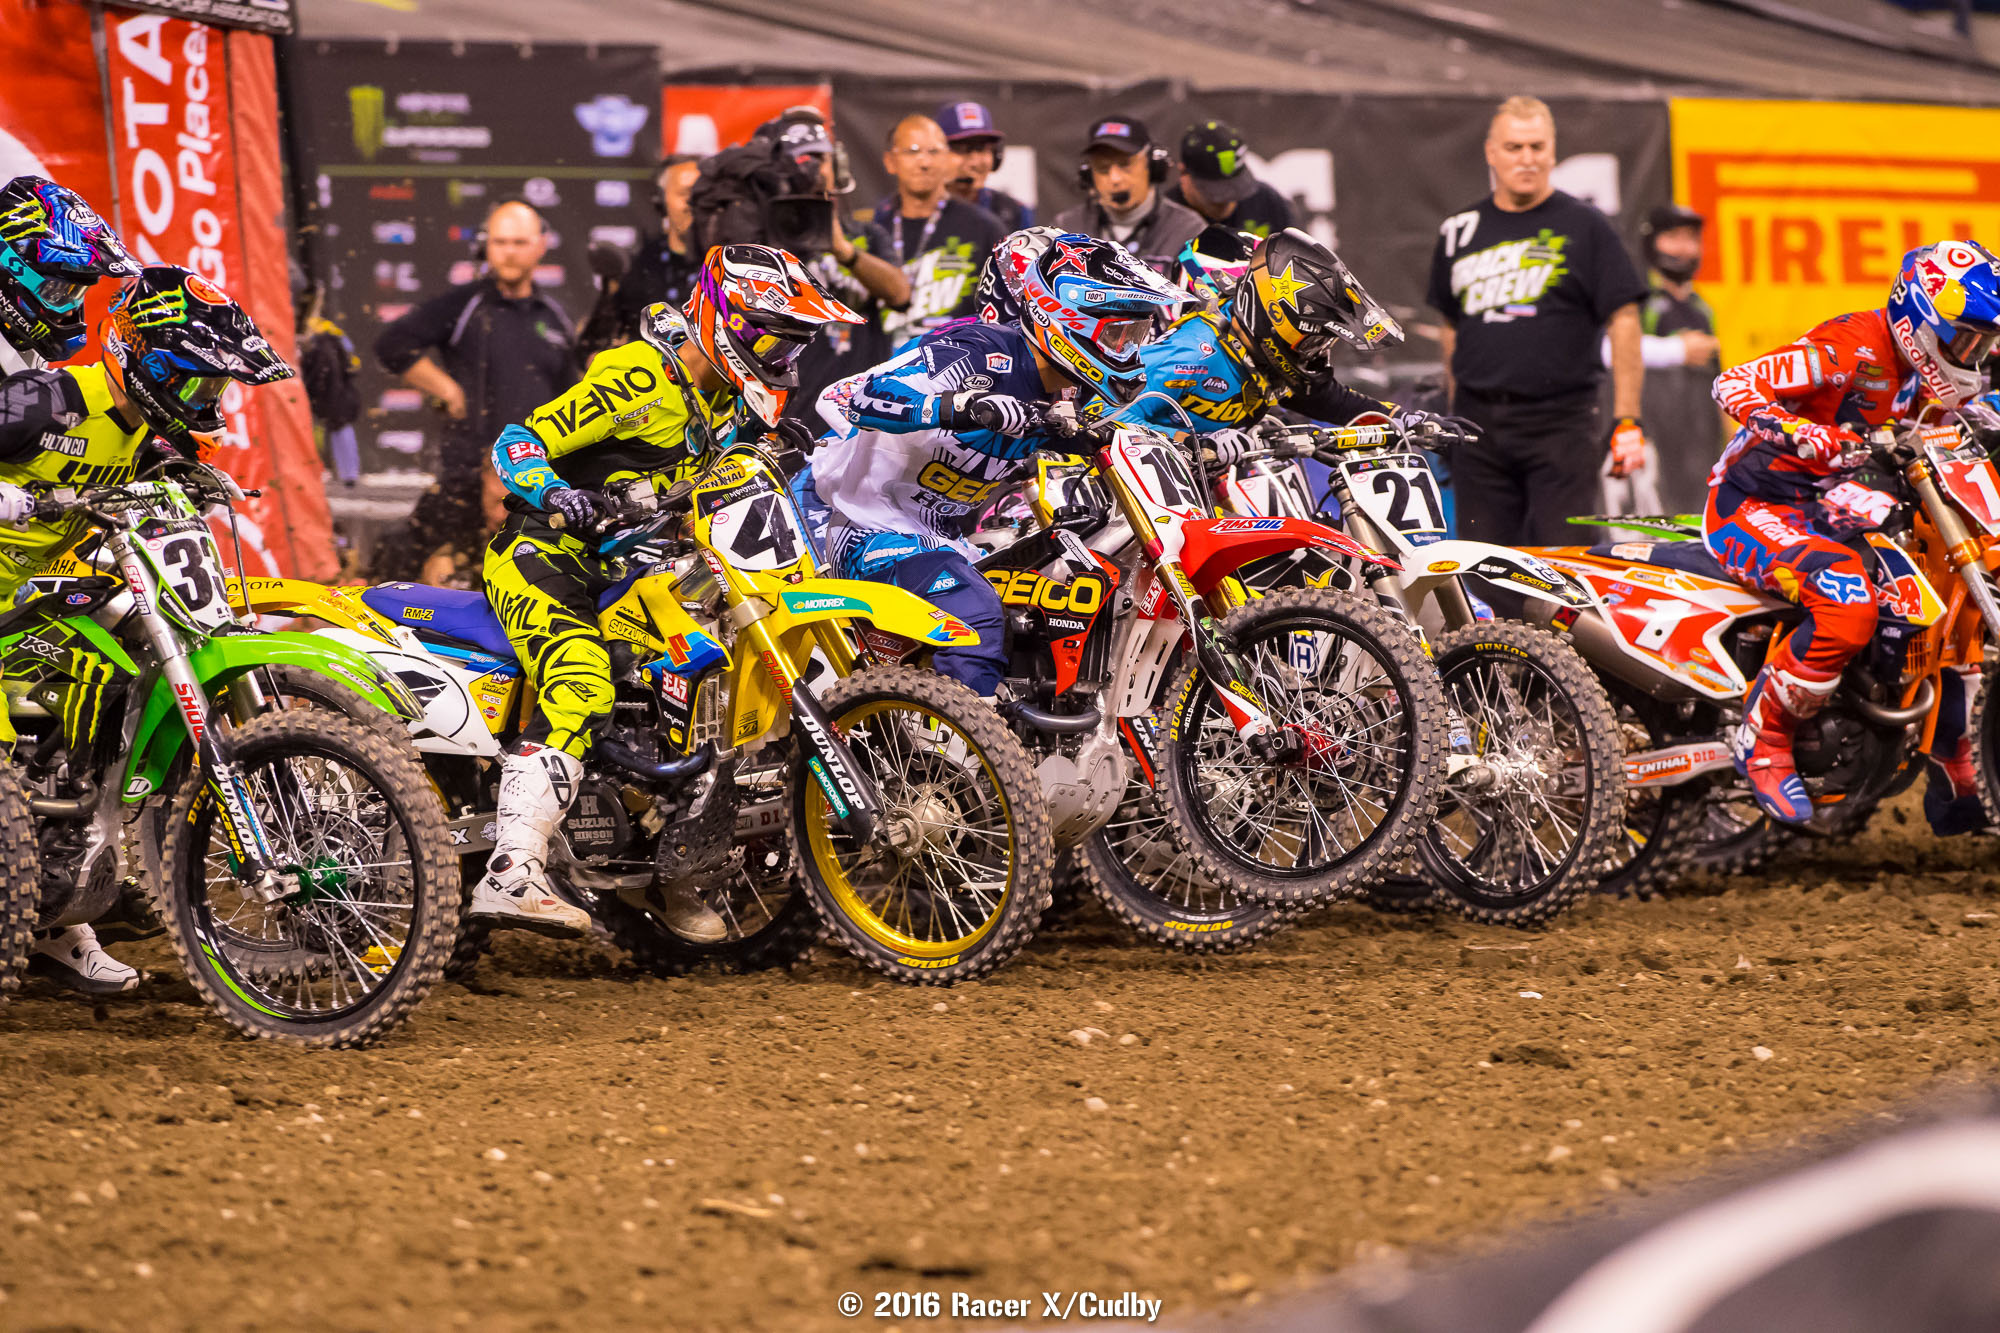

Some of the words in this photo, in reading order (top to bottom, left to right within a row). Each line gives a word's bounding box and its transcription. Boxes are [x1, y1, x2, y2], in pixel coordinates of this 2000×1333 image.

[177, 21, 217, 196] Place
[1463, 263, 1553, 316] CREW
[1029, 302, 1049, 326] Arai
[1894, 317, 1925, 364] Red
[989, 356, 1009, 369] 100%
[1049, 333, 1105, 385] GEICO
[1262, 337, 1298, 379] ROCKST
[963, 377, 991, 388] Arai
[1918, 360, 1958, 398] Bull
[1372, 470, 1446, 532] 21
[1964, 462, 2000, 521] 1
[730, 493, 798, 566] 4
[1209, 518, 1286, 533] AMSOIL
[654, 563, 668, 572] elf
[1510, 571, 1553, 591] ROCKSTAR
[933, 576, 957, 590] ANSR
[984, 568, 1103, 615] GEICO
[403, 608, 432, 620] RM-Z
[804, 597, 846, 609] MOTOREX
[608, 618, 650, 646] SUZUKI
[1048, 617, 1086, 631] HONDA
[19, 634, 65, 662] KX
[1474, 643, 1529, 658] DUNLOP
[1169, 667, 1199, 742] DUNLOP
[1229, 679, 1267, 712] GEICO
[798, 714, 866, 811] DUNLOP
[817, 771, 847, 815] MOTOREX
[211, 763, 261, 862] DUNLOP
[567, 816, 617, 830] SUZUKI
[1163, 920, 1234, 932] DUNLOP
[896, 954, 961, 969] DUNLOP
